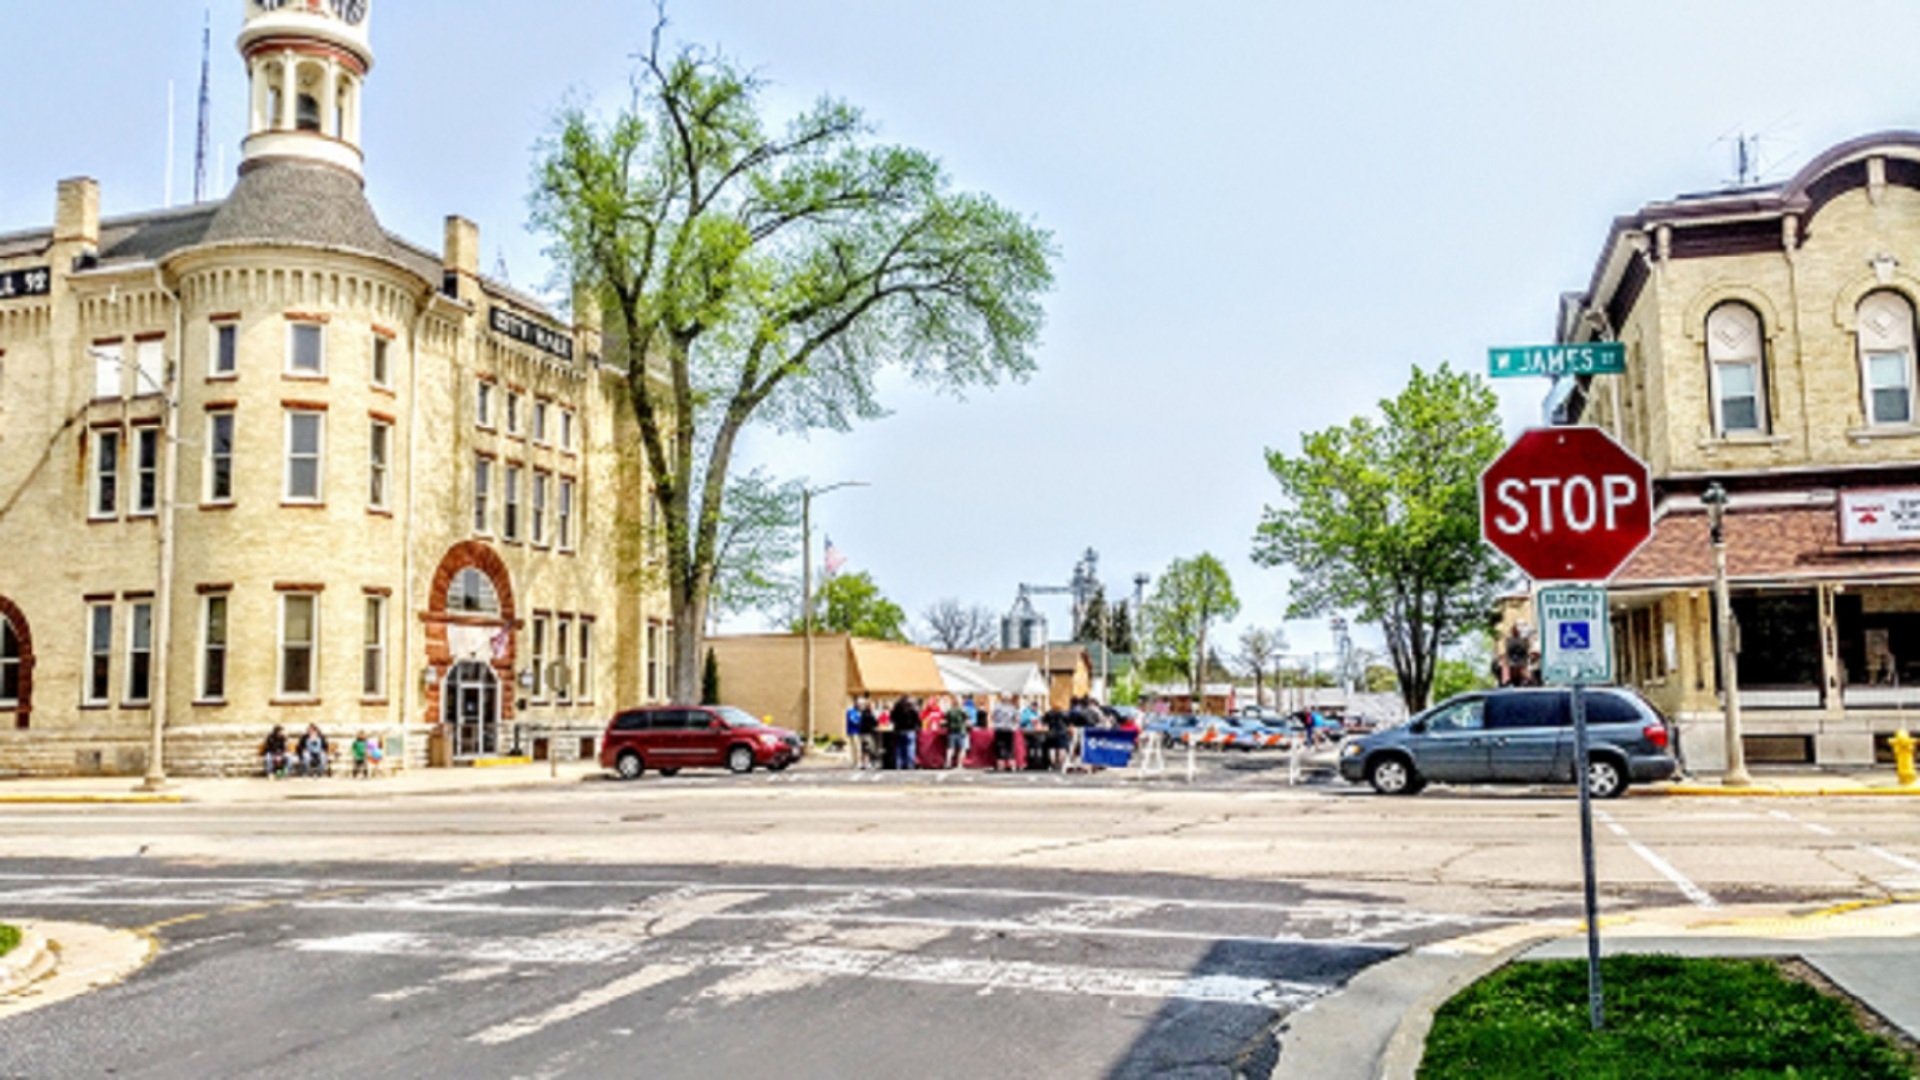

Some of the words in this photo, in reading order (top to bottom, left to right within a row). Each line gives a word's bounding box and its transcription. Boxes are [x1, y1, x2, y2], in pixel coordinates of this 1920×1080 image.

[1498, 352, 1511, 369] W
[1520, 347, 1593, 372] JAMES
[1494, 475, 1637, 534] STOP
